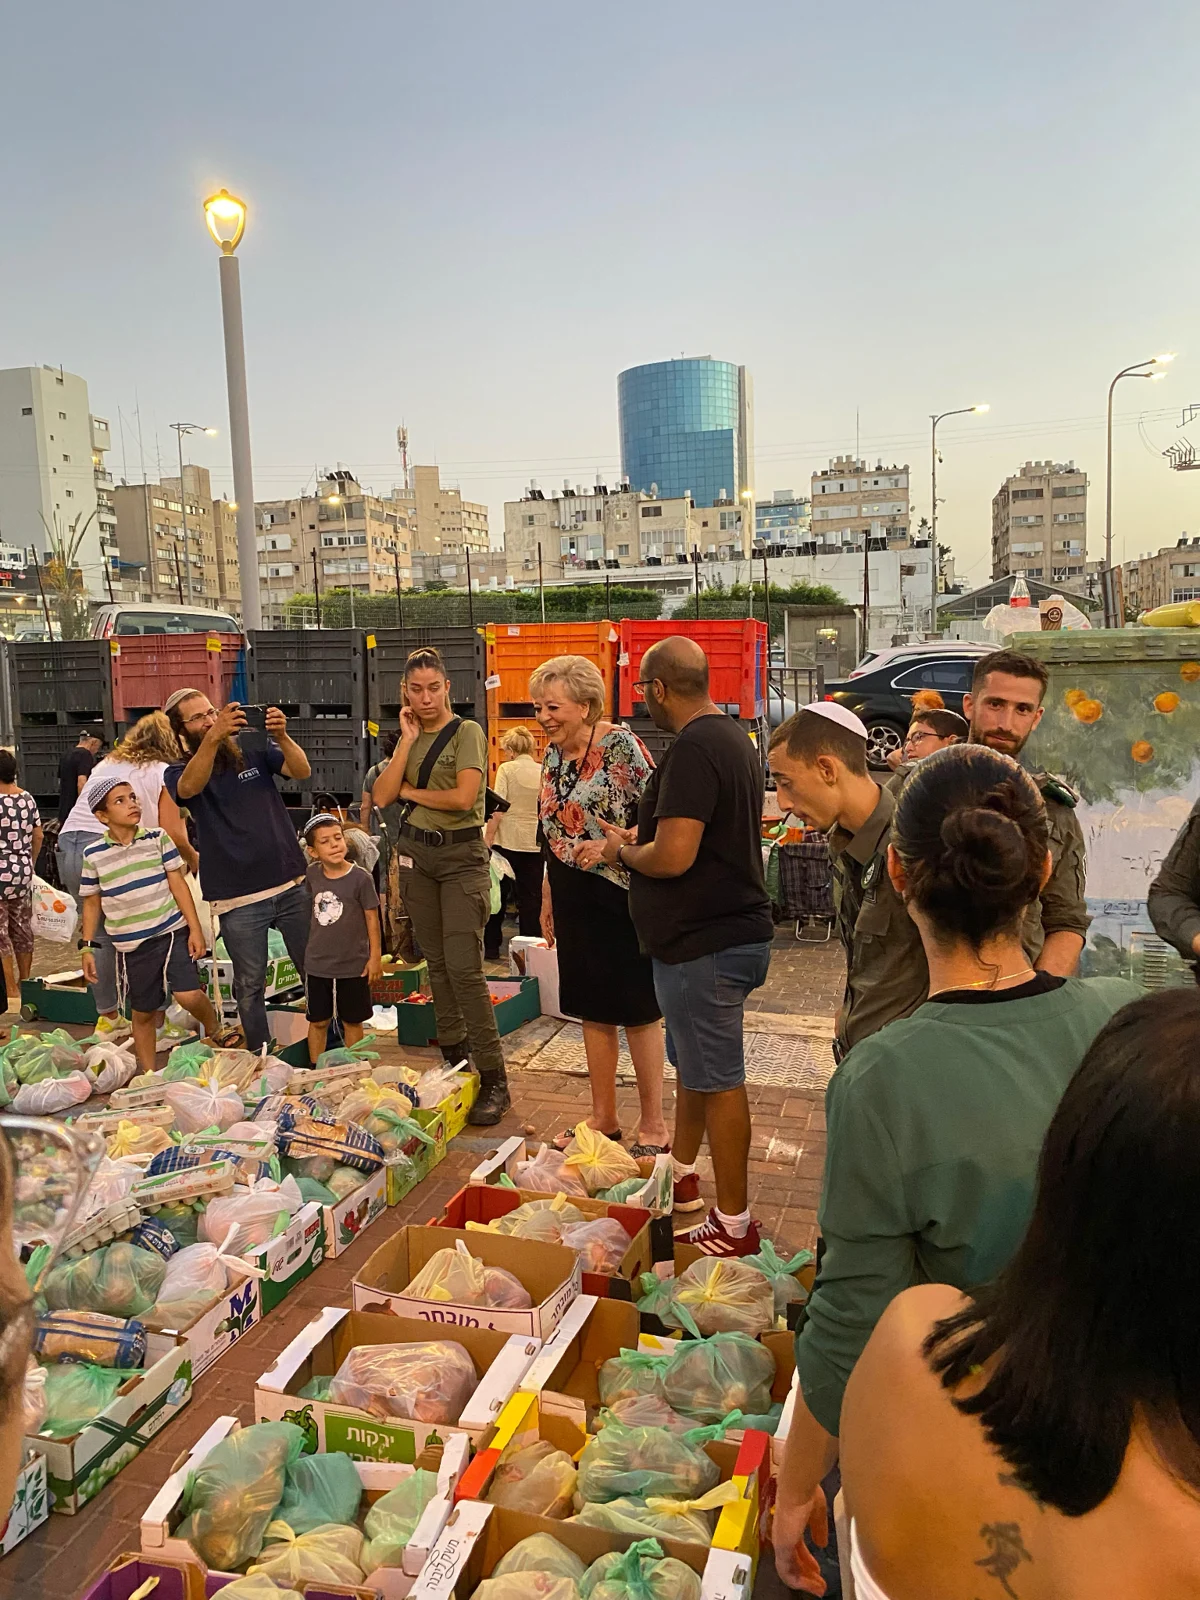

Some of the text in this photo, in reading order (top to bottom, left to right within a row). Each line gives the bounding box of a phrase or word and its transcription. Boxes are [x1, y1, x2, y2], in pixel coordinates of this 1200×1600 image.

[551, 1288, 571, 1319] מובחר
[346, 1427, 395, 1448] ירקות
[426, 1539, 460, 1591] משק ליבנה
